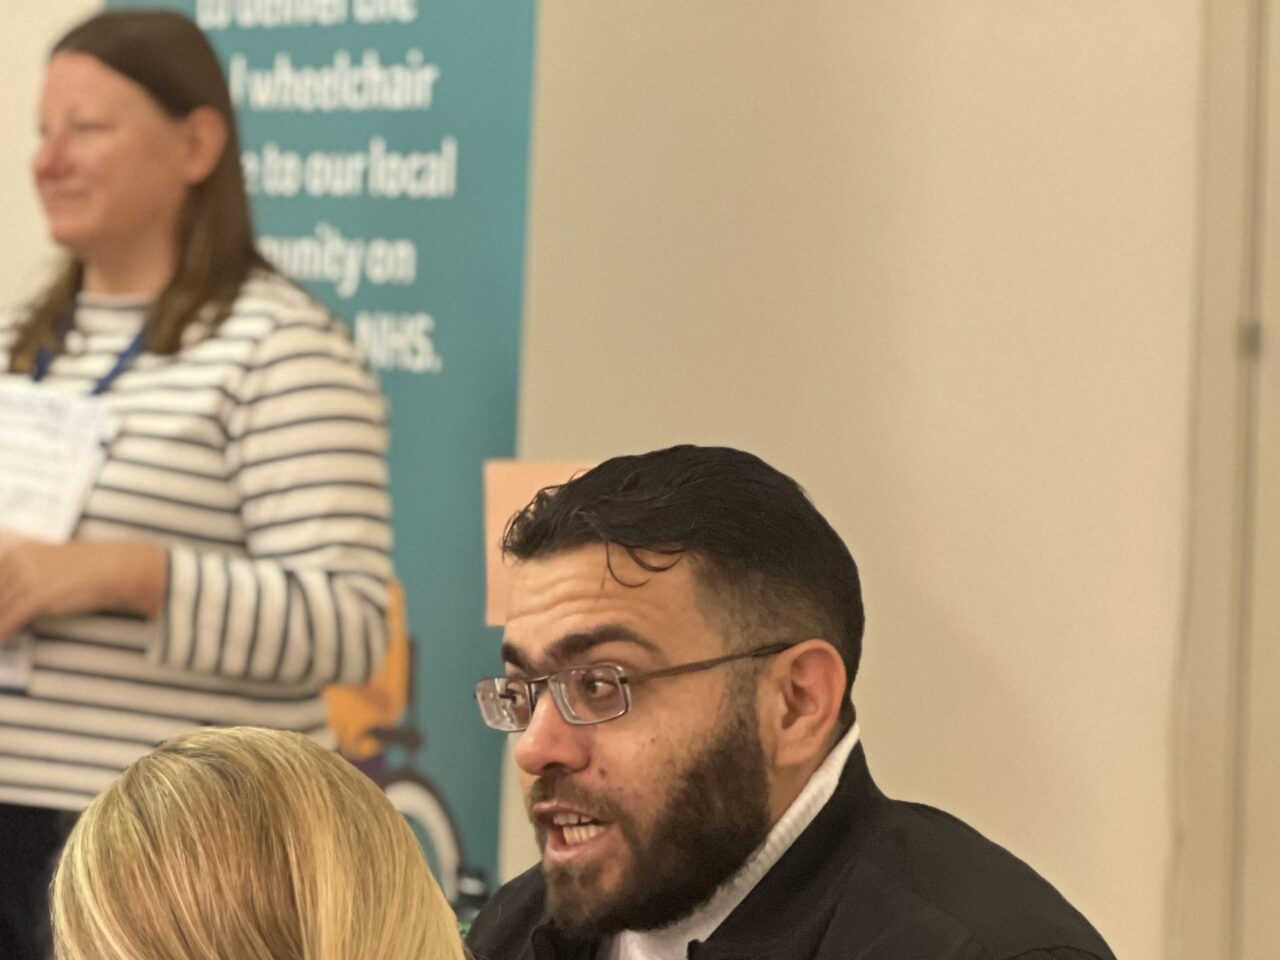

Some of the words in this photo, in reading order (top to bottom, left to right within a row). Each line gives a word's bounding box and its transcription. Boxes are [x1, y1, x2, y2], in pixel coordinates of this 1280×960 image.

[250, 49, 439, 111] wheelchair
[262, 143, 301, 196] to
[305, 151, 365, 196] our
[368, 137, 458, 197] local
[366, 238, 417, 283] on
